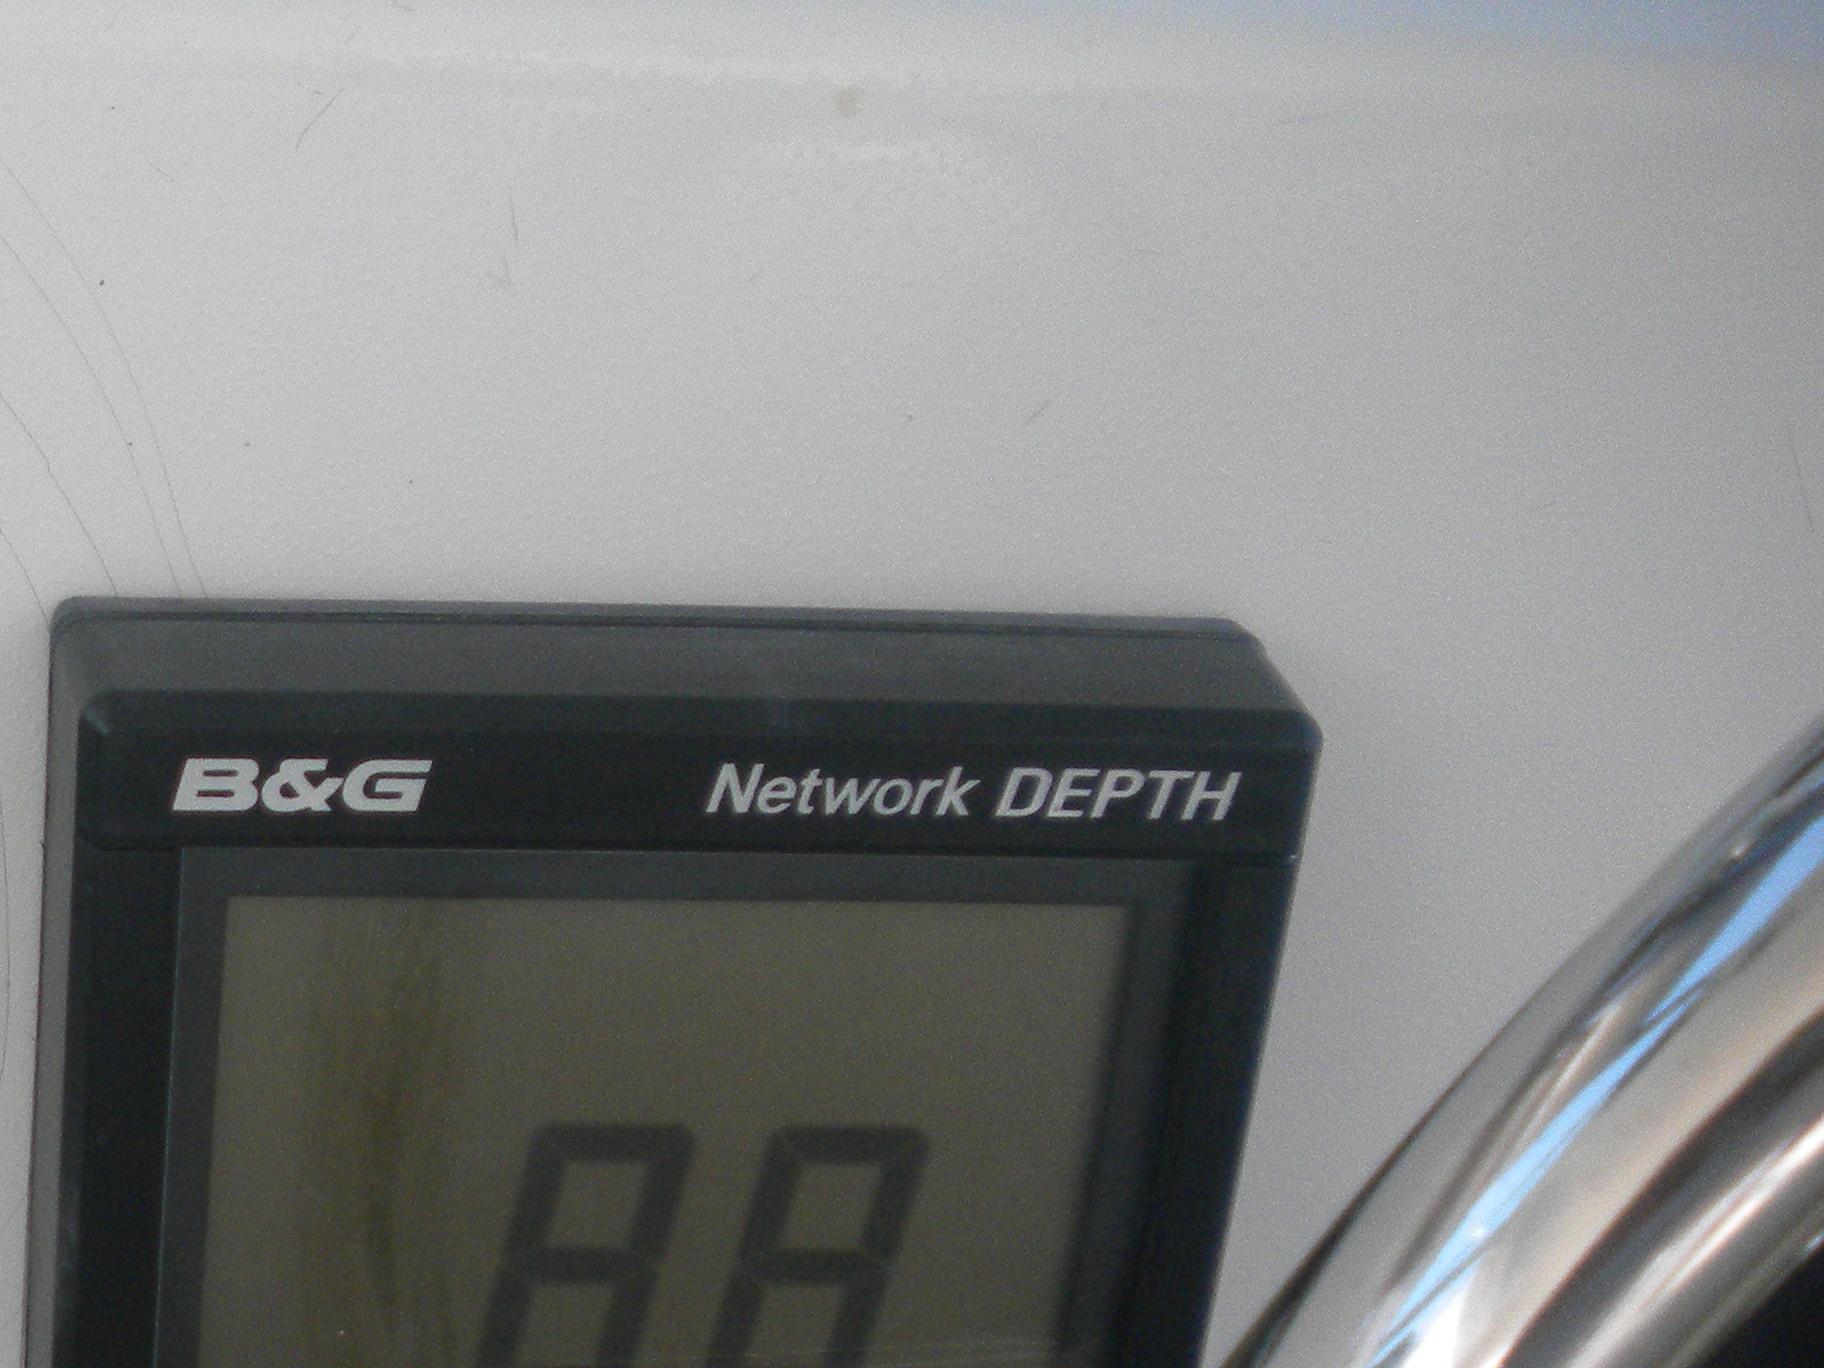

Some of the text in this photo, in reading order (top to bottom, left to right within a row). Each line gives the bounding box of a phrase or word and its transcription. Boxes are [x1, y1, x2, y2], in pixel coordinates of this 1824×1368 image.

[172, 758, 433, 813] B&G
[705, 762, 1242, 821] Network DEPTH
